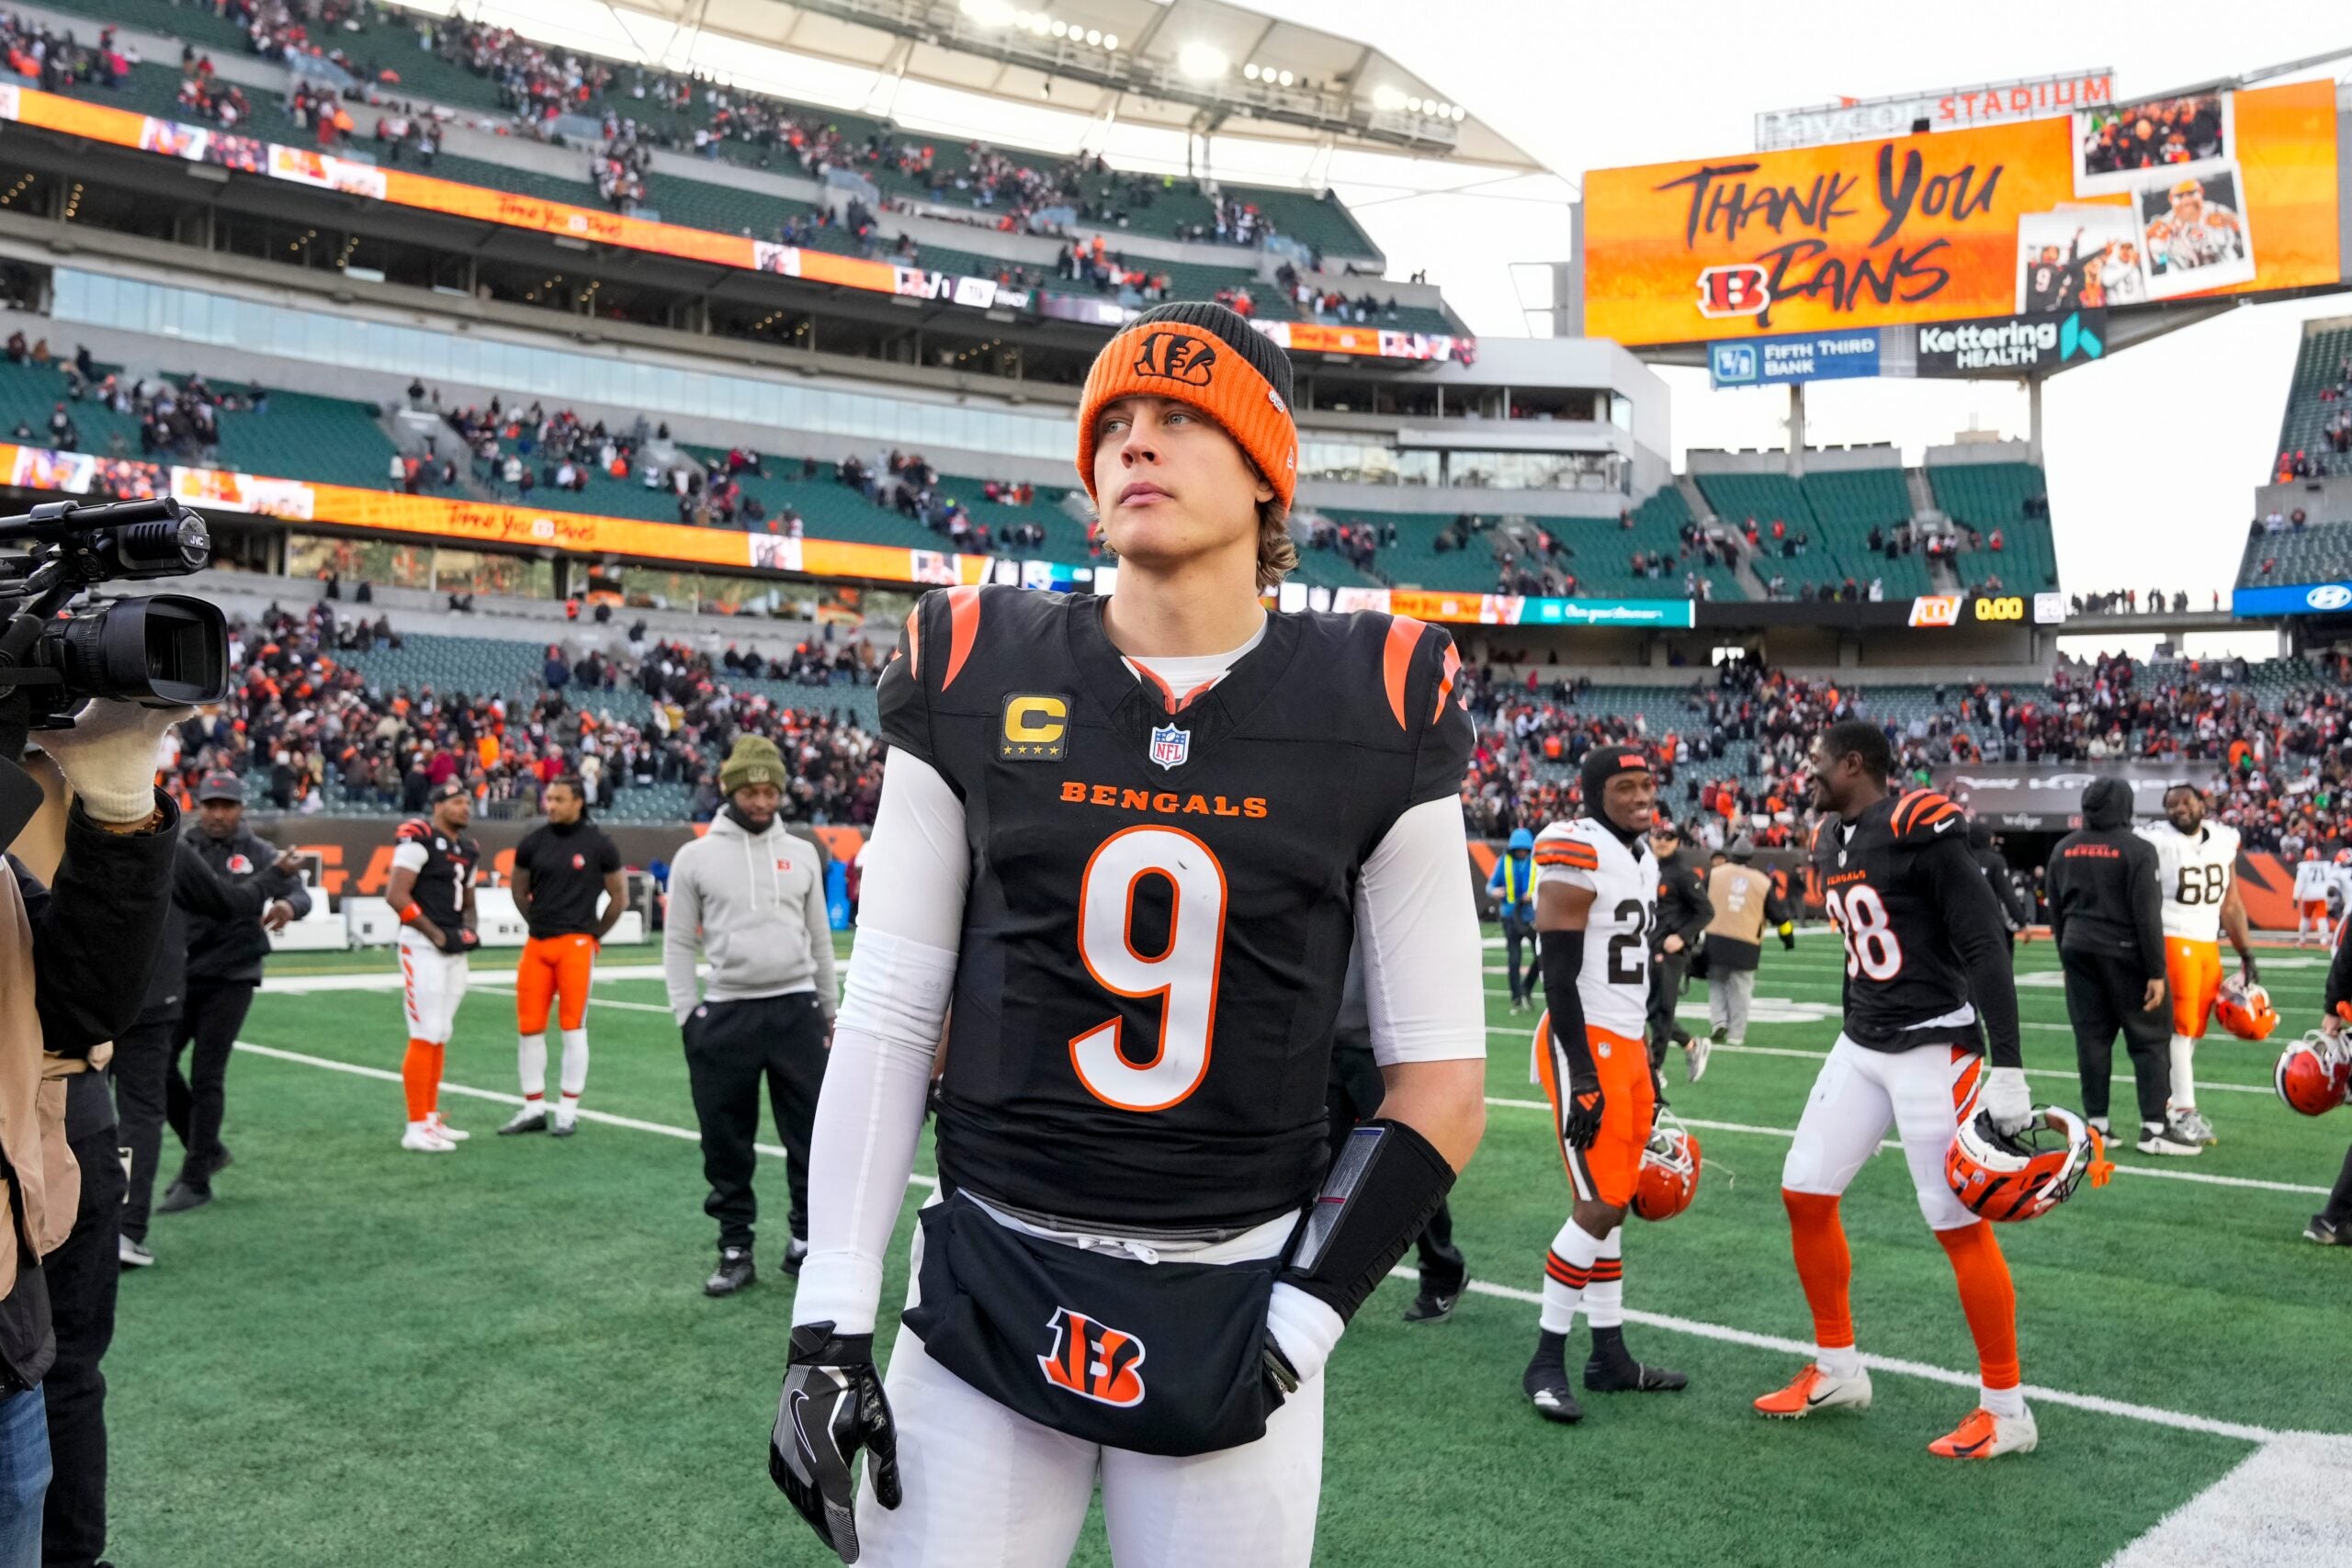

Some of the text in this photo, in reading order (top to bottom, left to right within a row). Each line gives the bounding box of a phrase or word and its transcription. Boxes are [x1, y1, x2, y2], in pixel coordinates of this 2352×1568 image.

[1939, 75, 2112, 119] STADIUM
[1764, 337, 1876, 360] FIFTH THIRD
[1919, 321, 2058, 354] Kettering
[1764, 359, 1815, 377] BANK
[1957, 346, 2038, 369] HEALTH
[190, 536, 204, 546] JVC
[1975, 596, 2023, 621] 0:00
[1004, 696, 1067, 743] C
[1156, 743, 1182, 761] NFL
[1059, 781, 1268, 818] BENGALS
[2175, 863, 2223, 906] 68
[2308, 866, 2326, 882] 71
[1068, 824, 1228, 1112] 9
